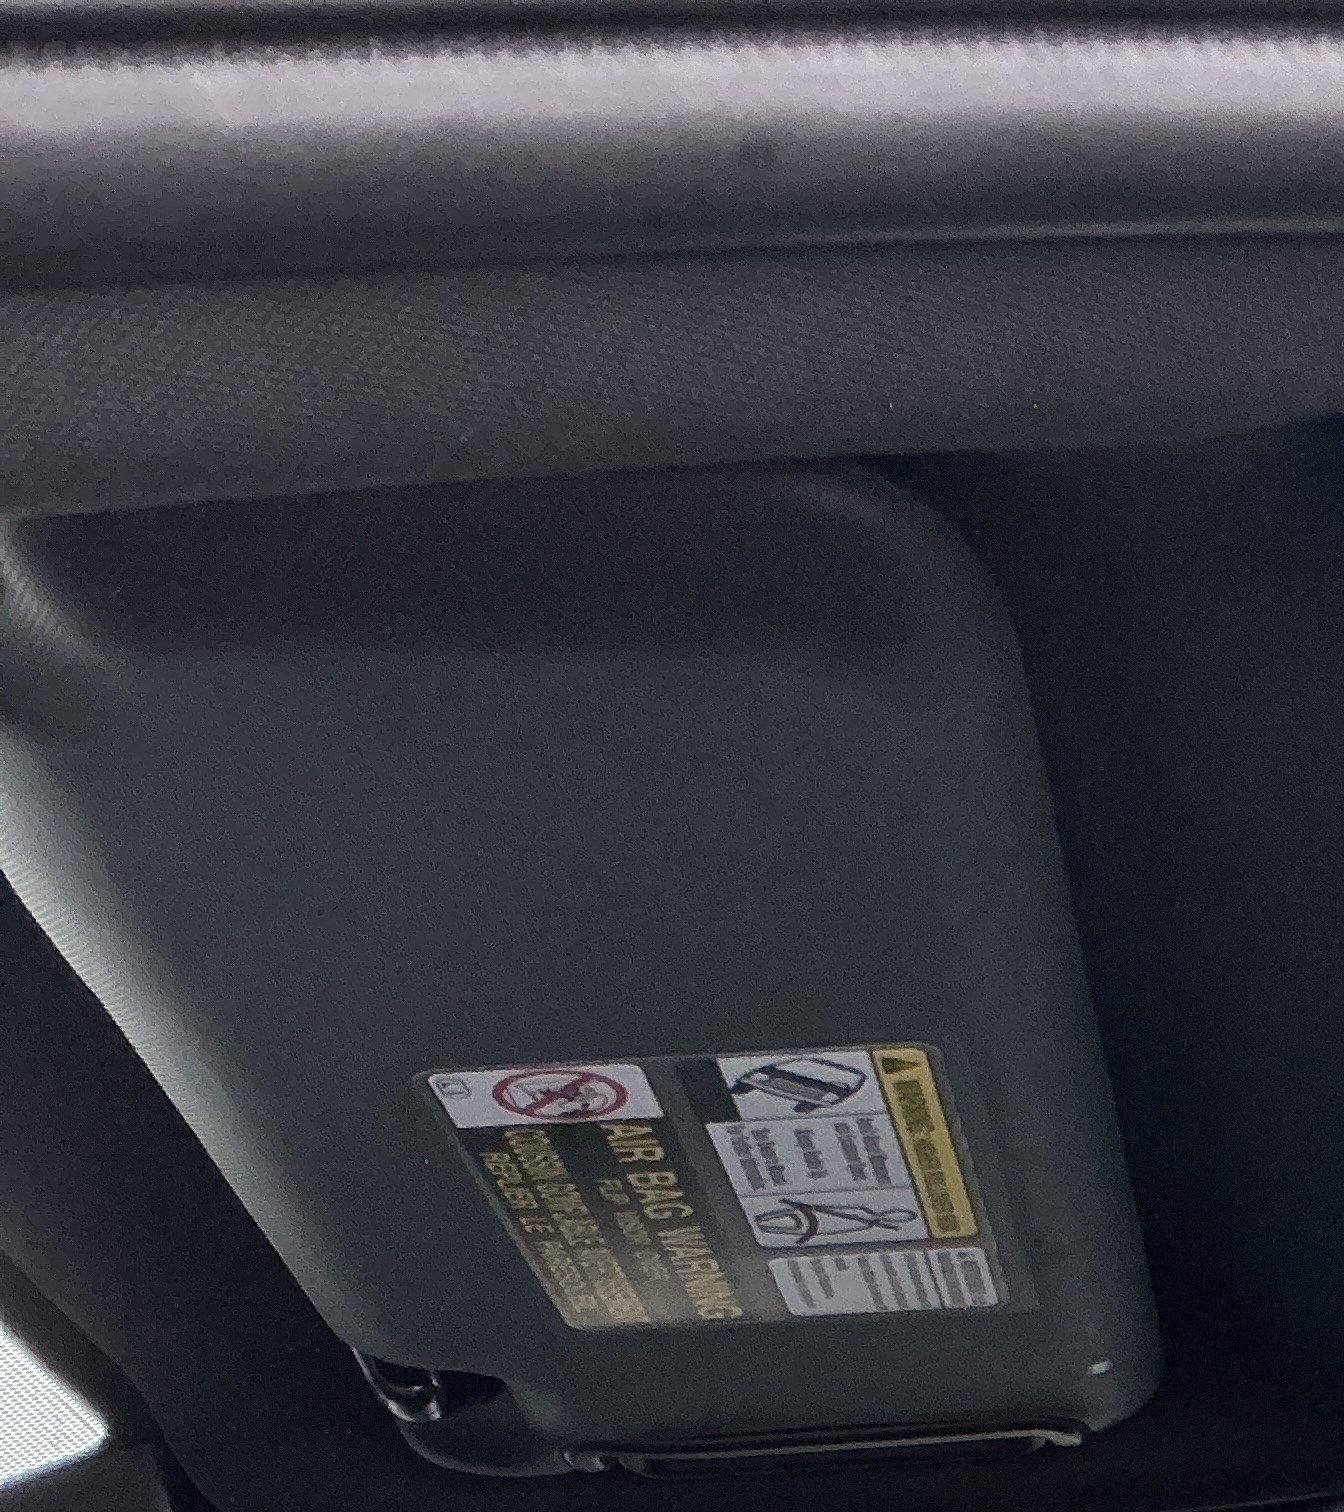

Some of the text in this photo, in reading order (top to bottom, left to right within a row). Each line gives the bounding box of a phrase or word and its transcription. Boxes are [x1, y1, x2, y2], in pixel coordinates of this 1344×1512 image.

[599, 1122, 667, 1162] AIR
[625, 1171, 697, 1219] BAG
[653, 1225, 746, 1319] WARNING
